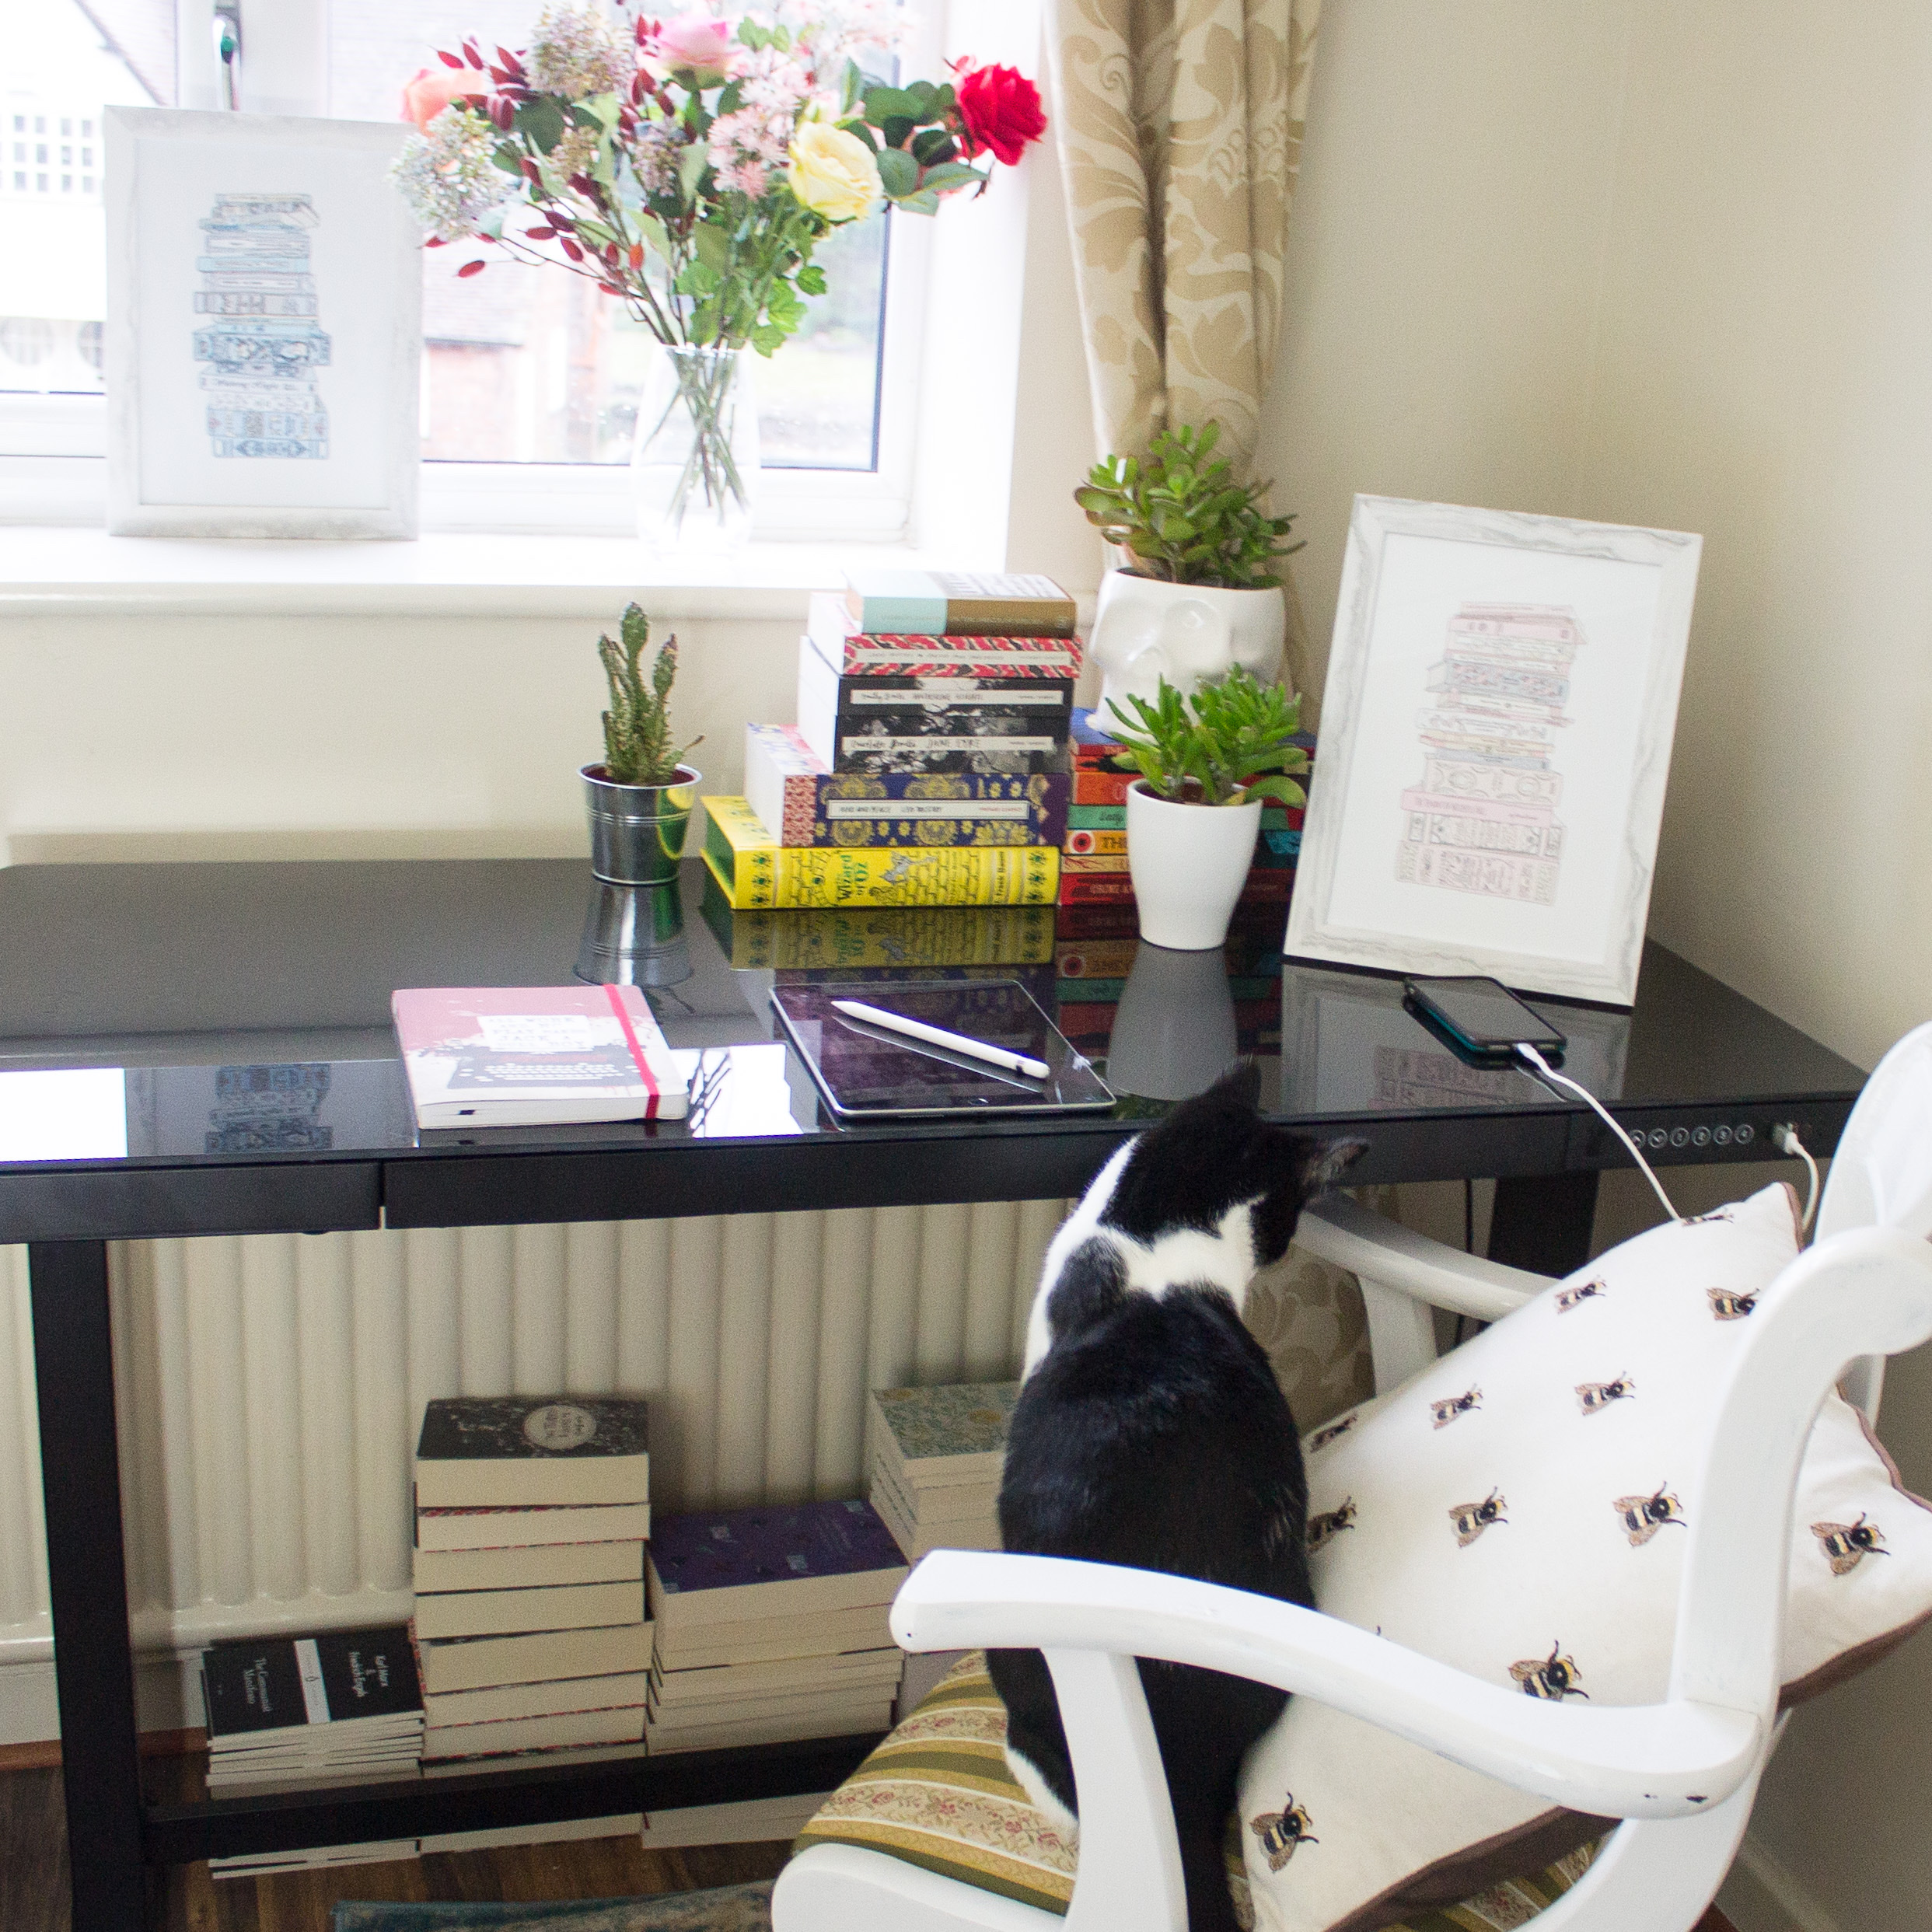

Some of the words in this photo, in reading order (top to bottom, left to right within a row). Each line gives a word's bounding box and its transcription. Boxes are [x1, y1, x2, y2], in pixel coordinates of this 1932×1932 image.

[836, 854, 852, 902] Wizard
[854, 861, 868, 882] Oz
[376, 1655, 390, 1668] Karl
[378, 1669, 389, 1687] Marx
